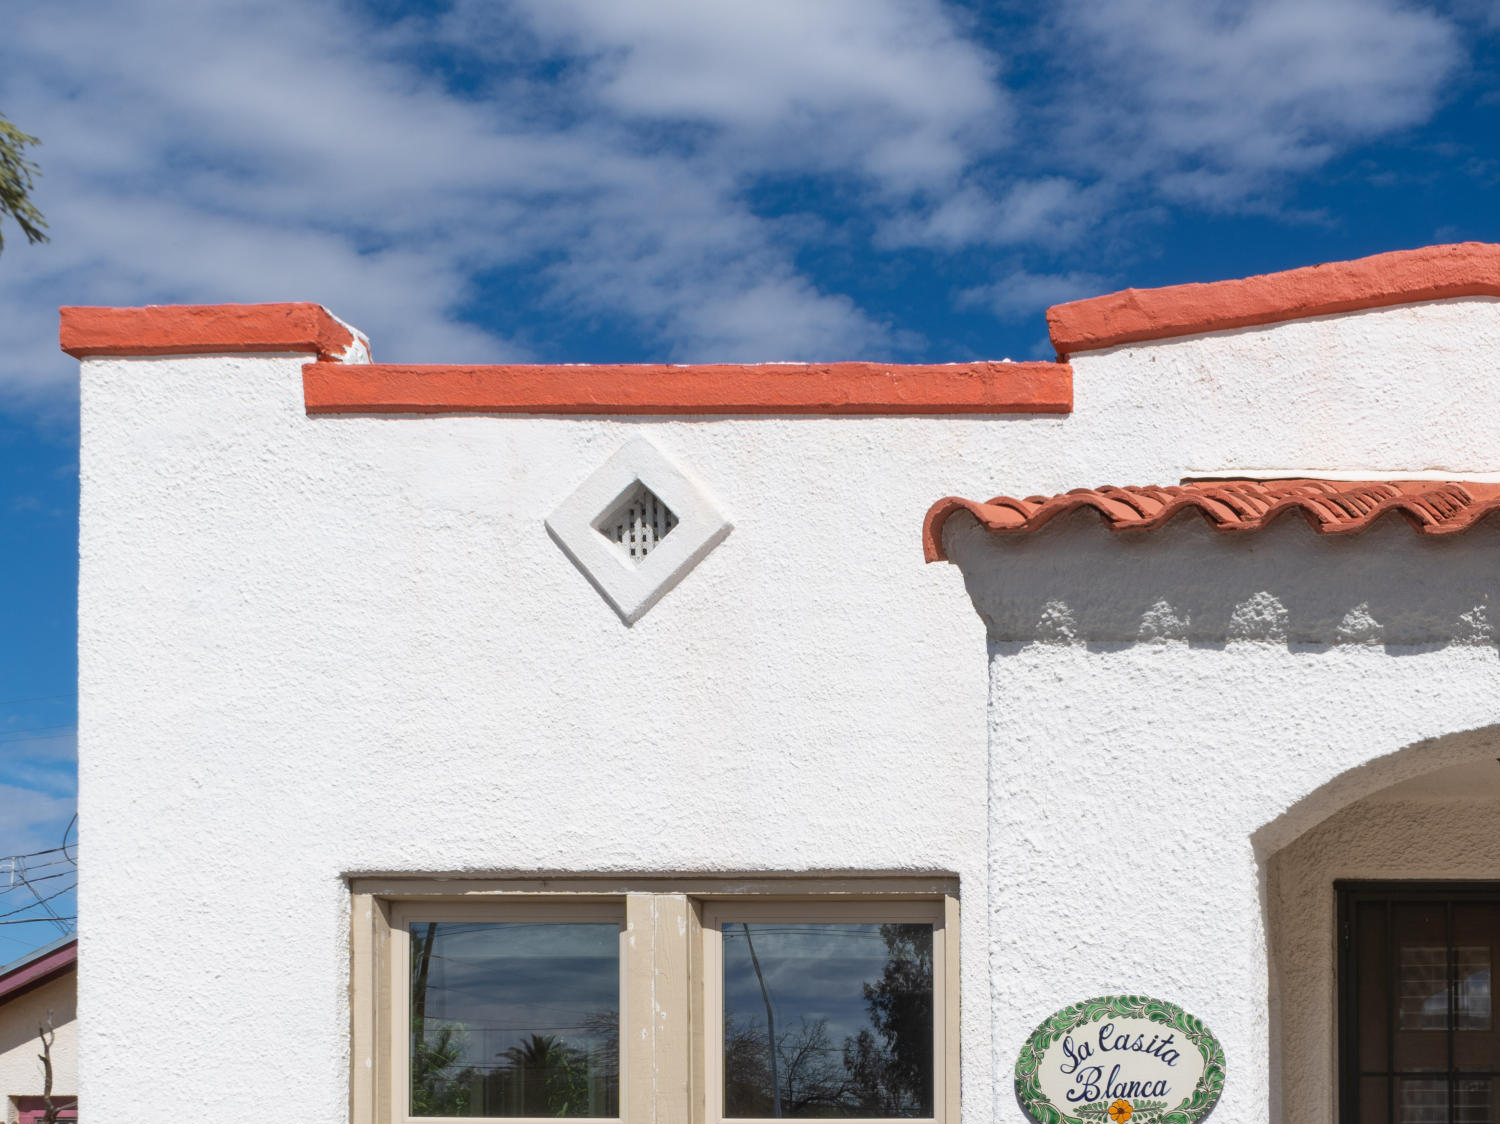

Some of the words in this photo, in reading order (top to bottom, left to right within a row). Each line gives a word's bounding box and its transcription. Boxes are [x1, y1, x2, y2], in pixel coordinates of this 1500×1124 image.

[1060, 1035, 1094, 1074] La
[1098, 1023, 1180, 1067] Casita
[1066, 1064, 1171, 1102] Blanca
